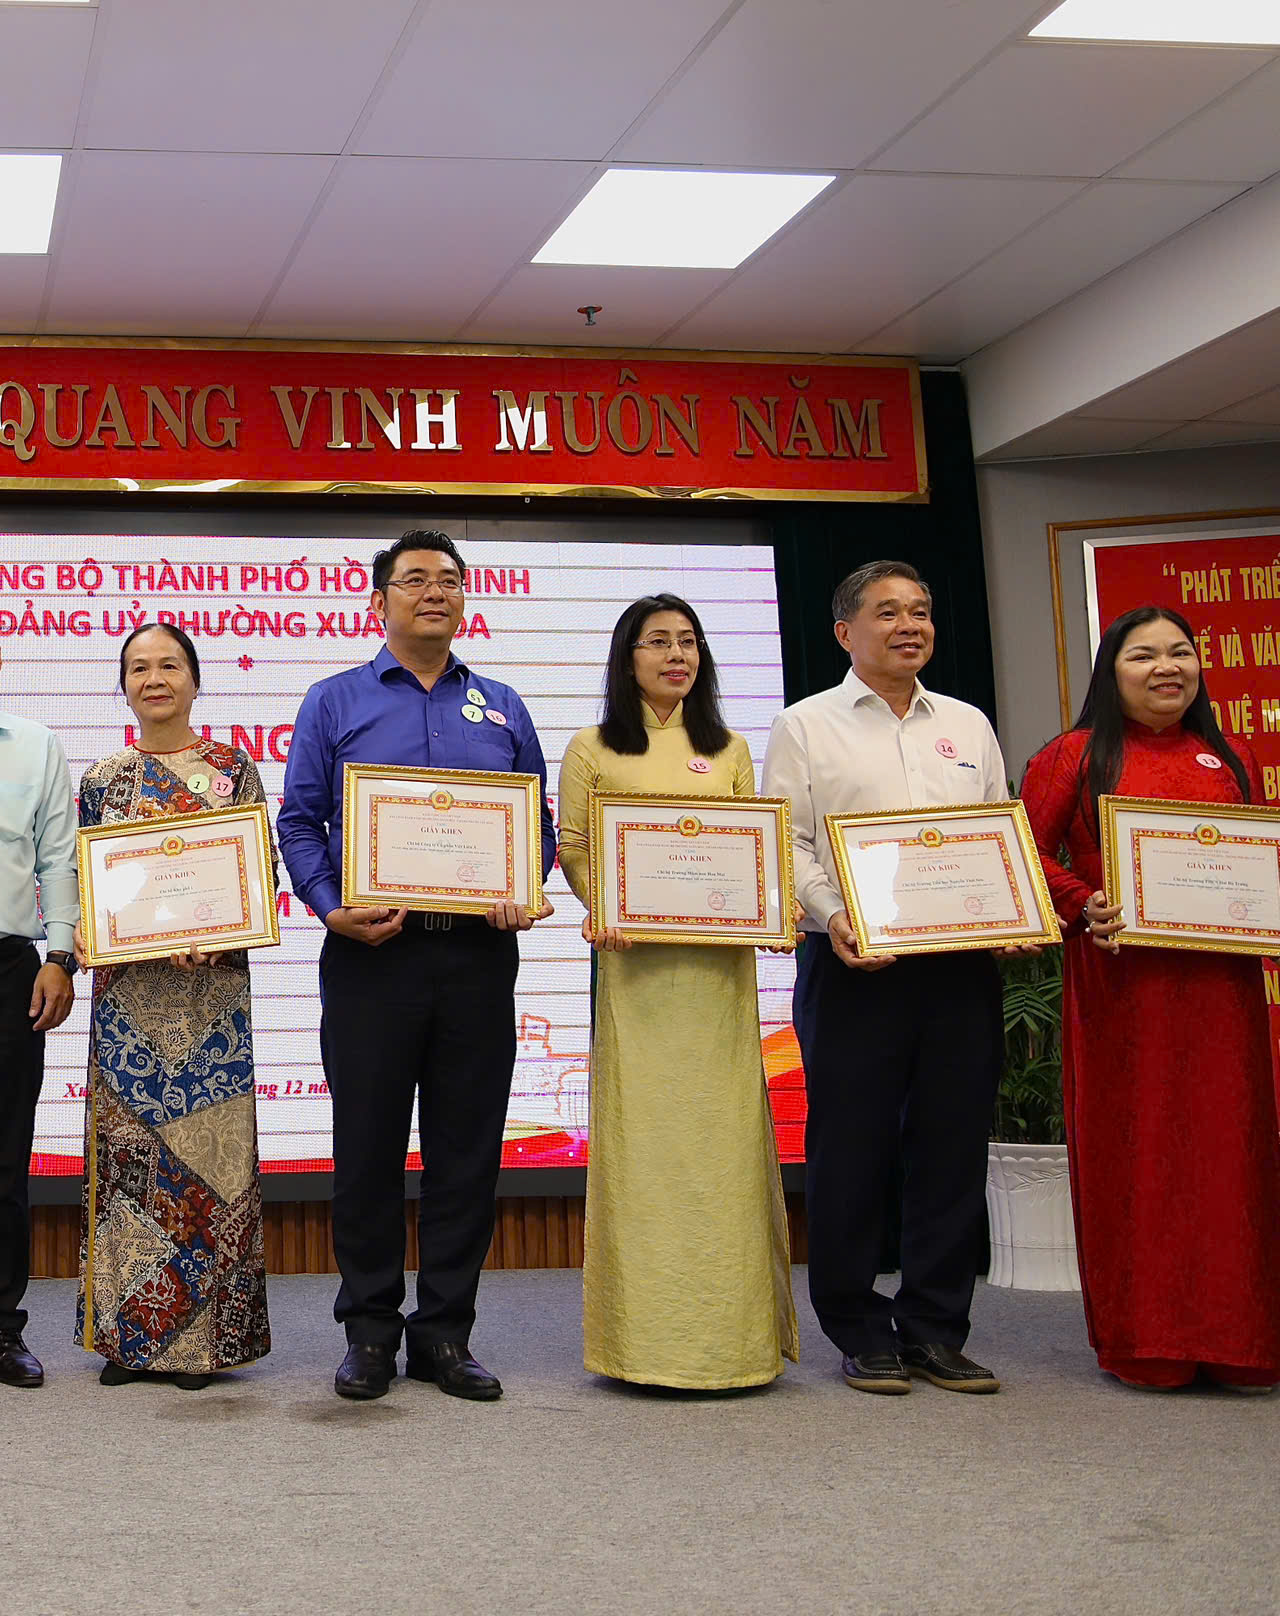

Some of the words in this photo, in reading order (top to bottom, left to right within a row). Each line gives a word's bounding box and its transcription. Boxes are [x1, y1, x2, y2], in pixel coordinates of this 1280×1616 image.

[270, 385, 462, 452] VINH
[492, 366, 701, 454] MUÔN
[731, 374, 889, 459] NĂM
[56, 557, 104, 597] BỘ
[112, 557, 229, 591] THÀNH
[240, 556, 310, 592] PHỐ
[320, 556, 369, 592] HỒ
[462, 568, 530, 594] INH
[157, 604, 307, 637] PHƯỜNG
[316, 604, 386, 639] XUÂ
[1219, 626, 1245, 668] VÀ
[1228, 693, 1254, 740] VỆ
[941, 745, 954, 754] 14
[215, 782, 229, 792] 17
[283, 1080, 304, 1095] 12
